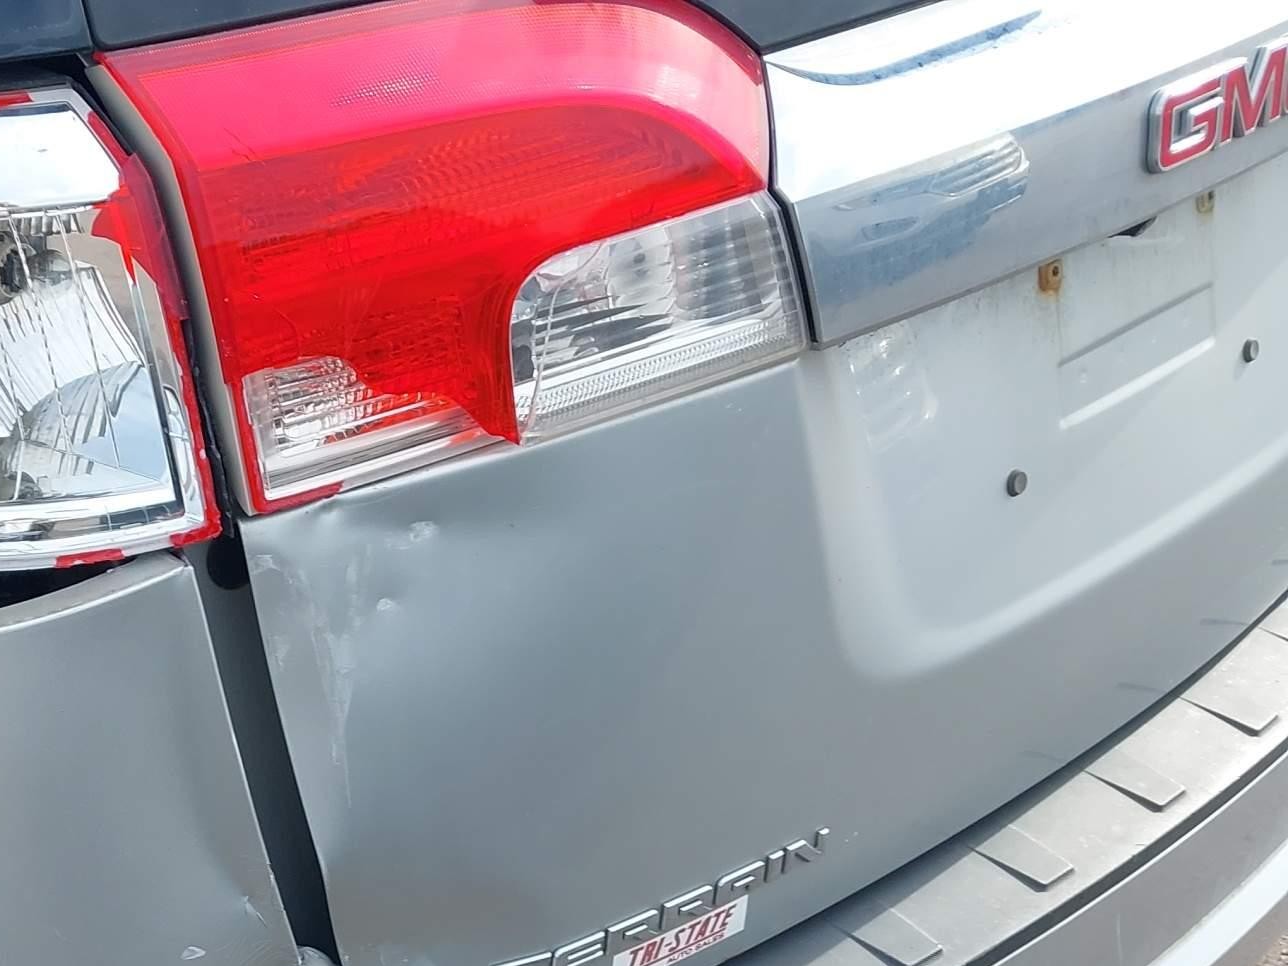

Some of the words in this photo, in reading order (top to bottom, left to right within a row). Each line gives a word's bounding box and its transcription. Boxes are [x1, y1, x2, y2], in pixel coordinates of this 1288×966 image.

[1148, 36, 1288, 173] GM
[667, 947, 694, 963] AUTO
[695, 933, 725, 951] SALES
